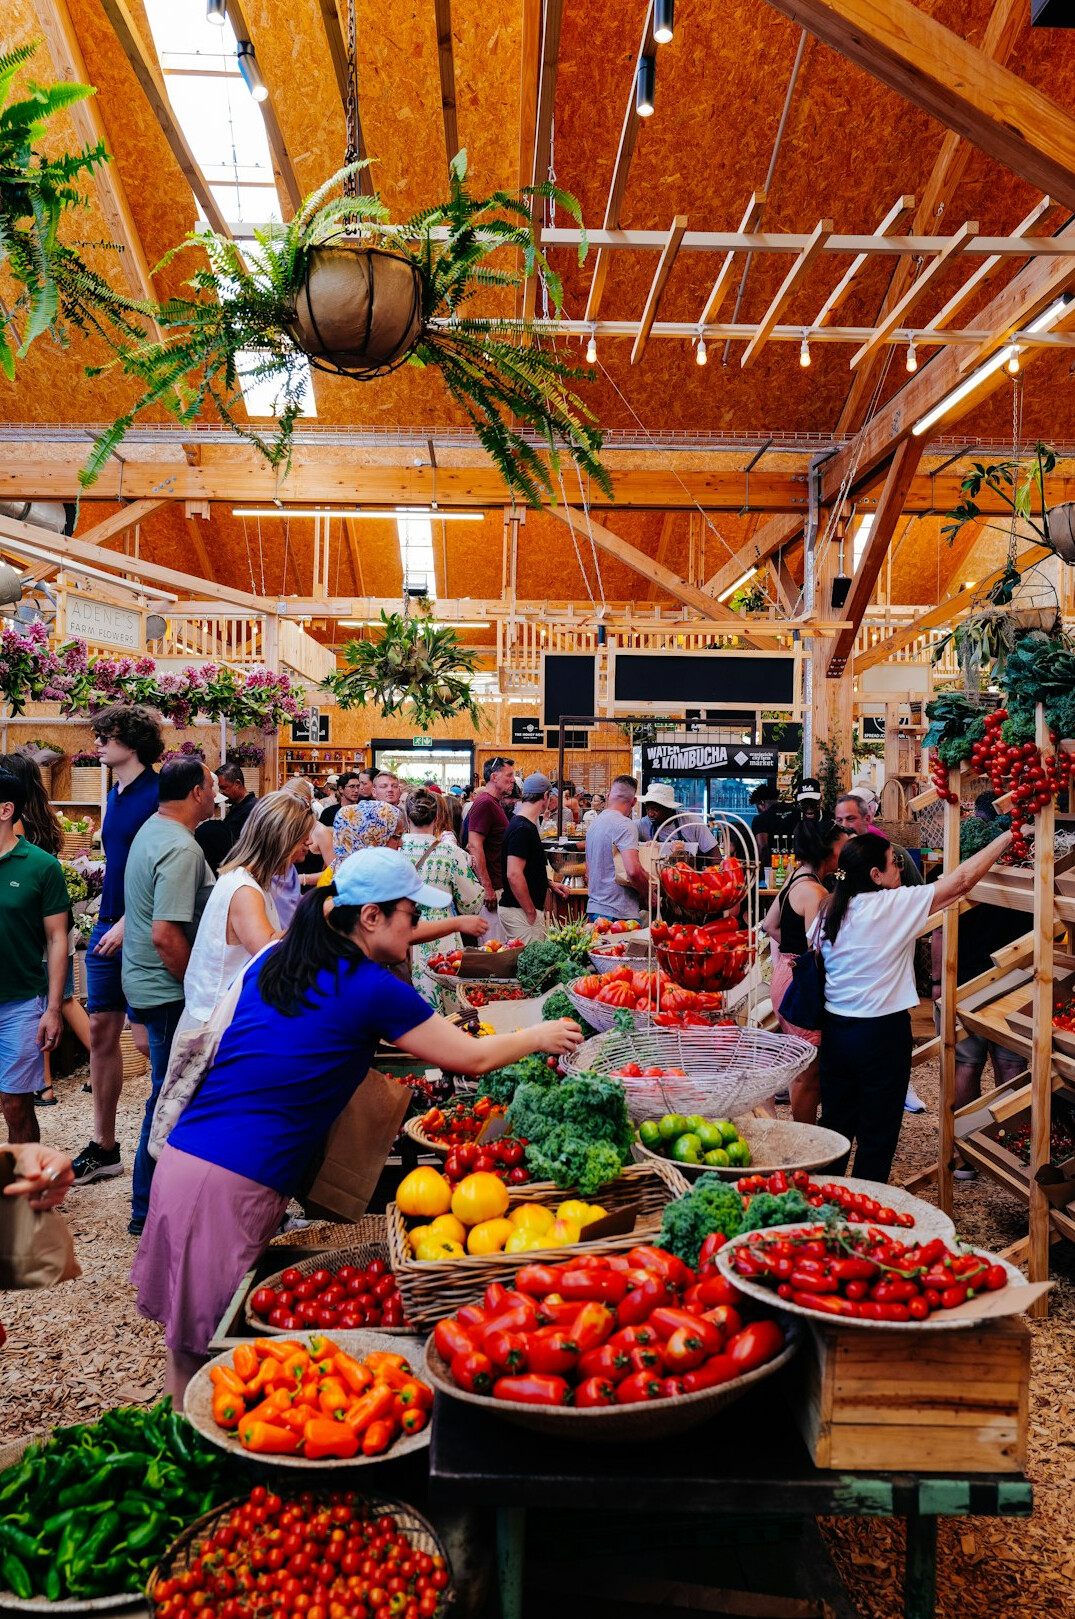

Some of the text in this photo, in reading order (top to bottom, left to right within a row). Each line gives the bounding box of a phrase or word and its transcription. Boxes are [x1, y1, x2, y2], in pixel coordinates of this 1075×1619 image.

[72, 602, 133, 629] ADENE'S
[70, 622, 133, 644] FARM FLOWERS
[647, 745, 680, 760] WATER
[651, 746, 729, 769] & KOMBUCHA
[749, 759, 774, 767] market
